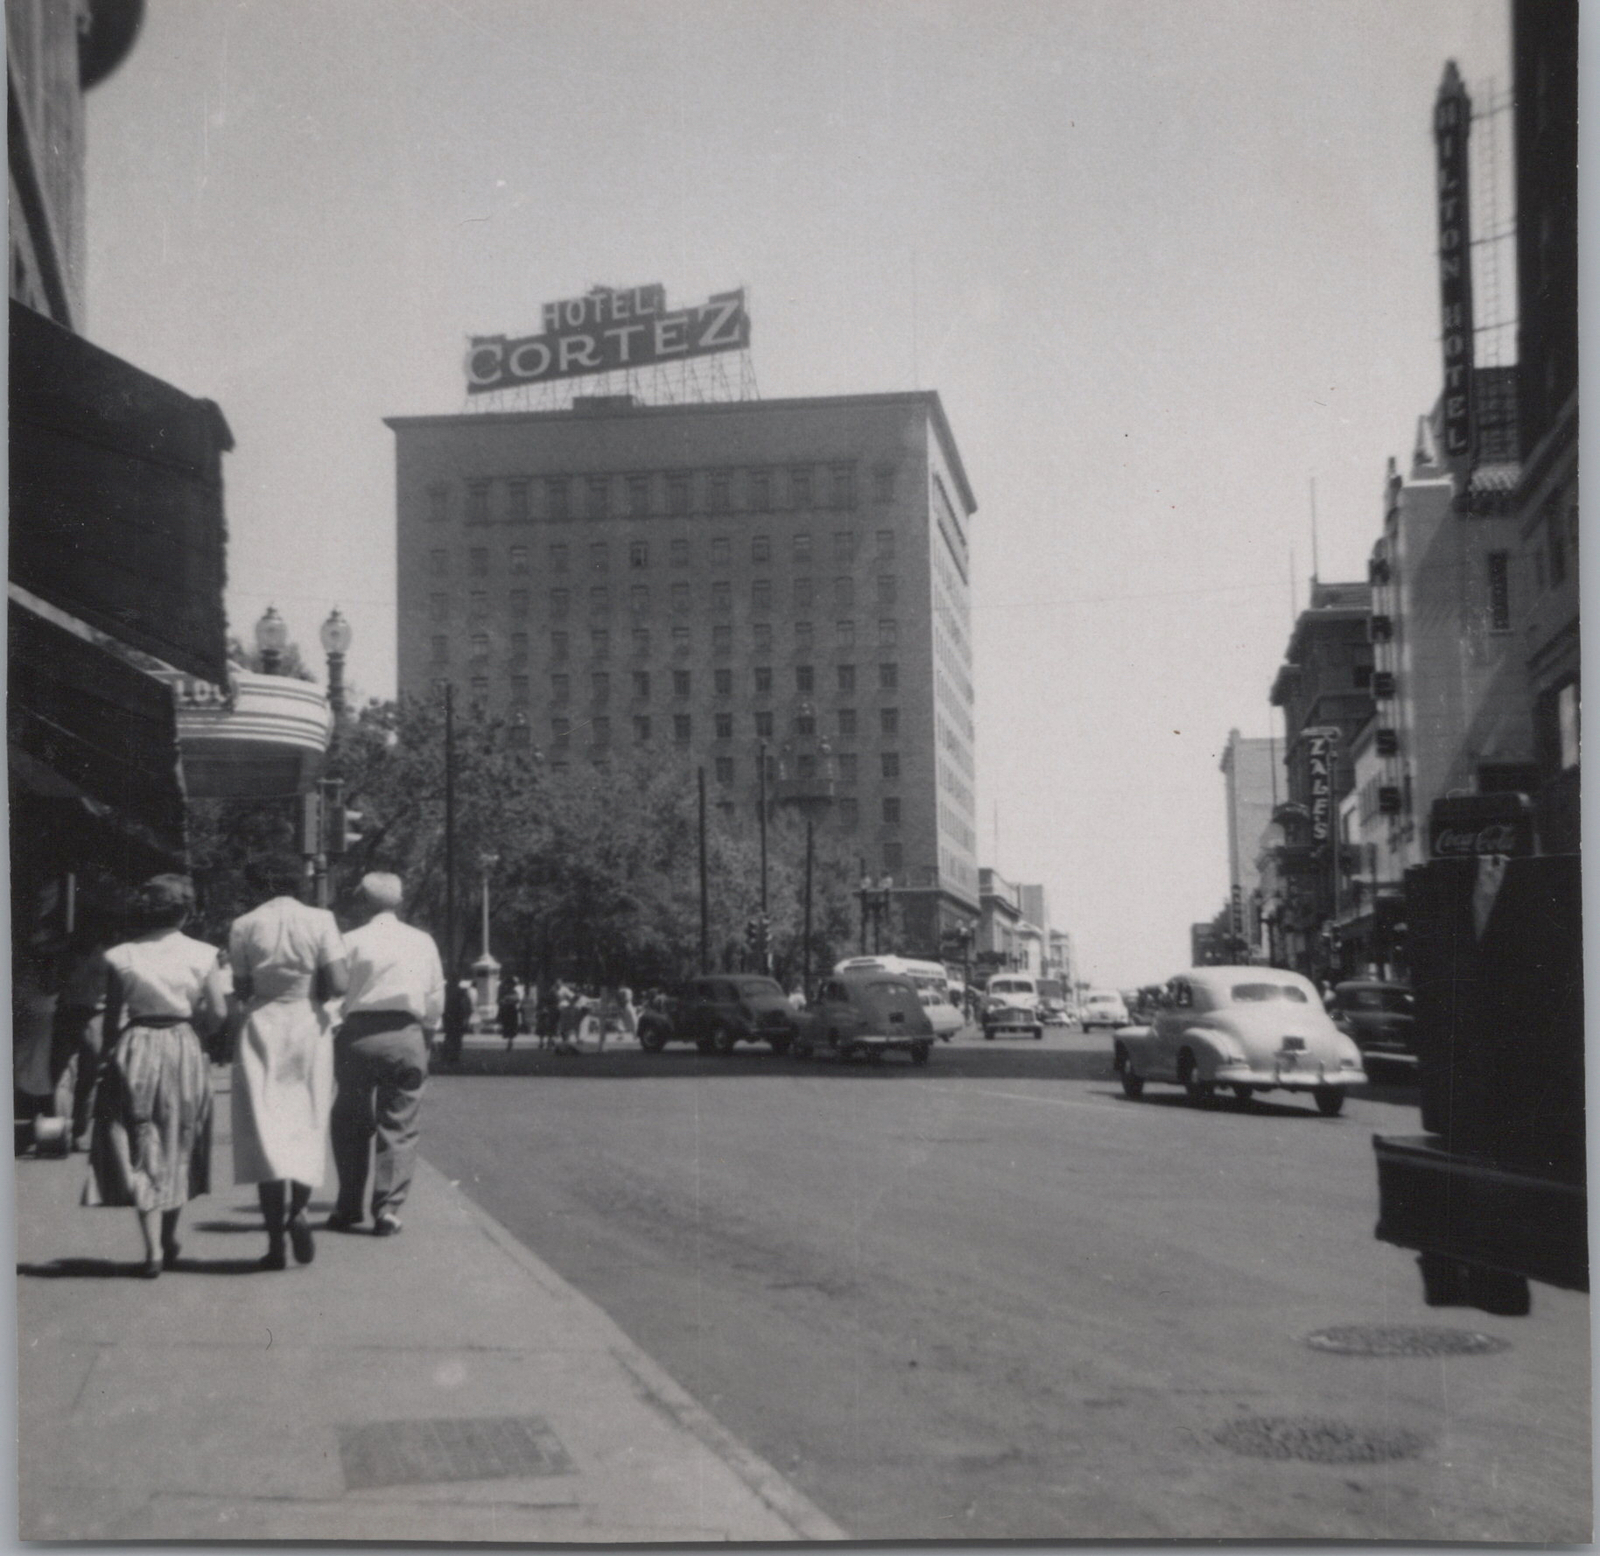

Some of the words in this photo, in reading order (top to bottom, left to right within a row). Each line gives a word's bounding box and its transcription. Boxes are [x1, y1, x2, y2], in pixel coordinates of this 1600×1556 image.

[466, 300, 741, 385] CORTEZ
[545, 285, 655, 329] HOTEL
[1443, 303, 1464, 451] HOTEL
